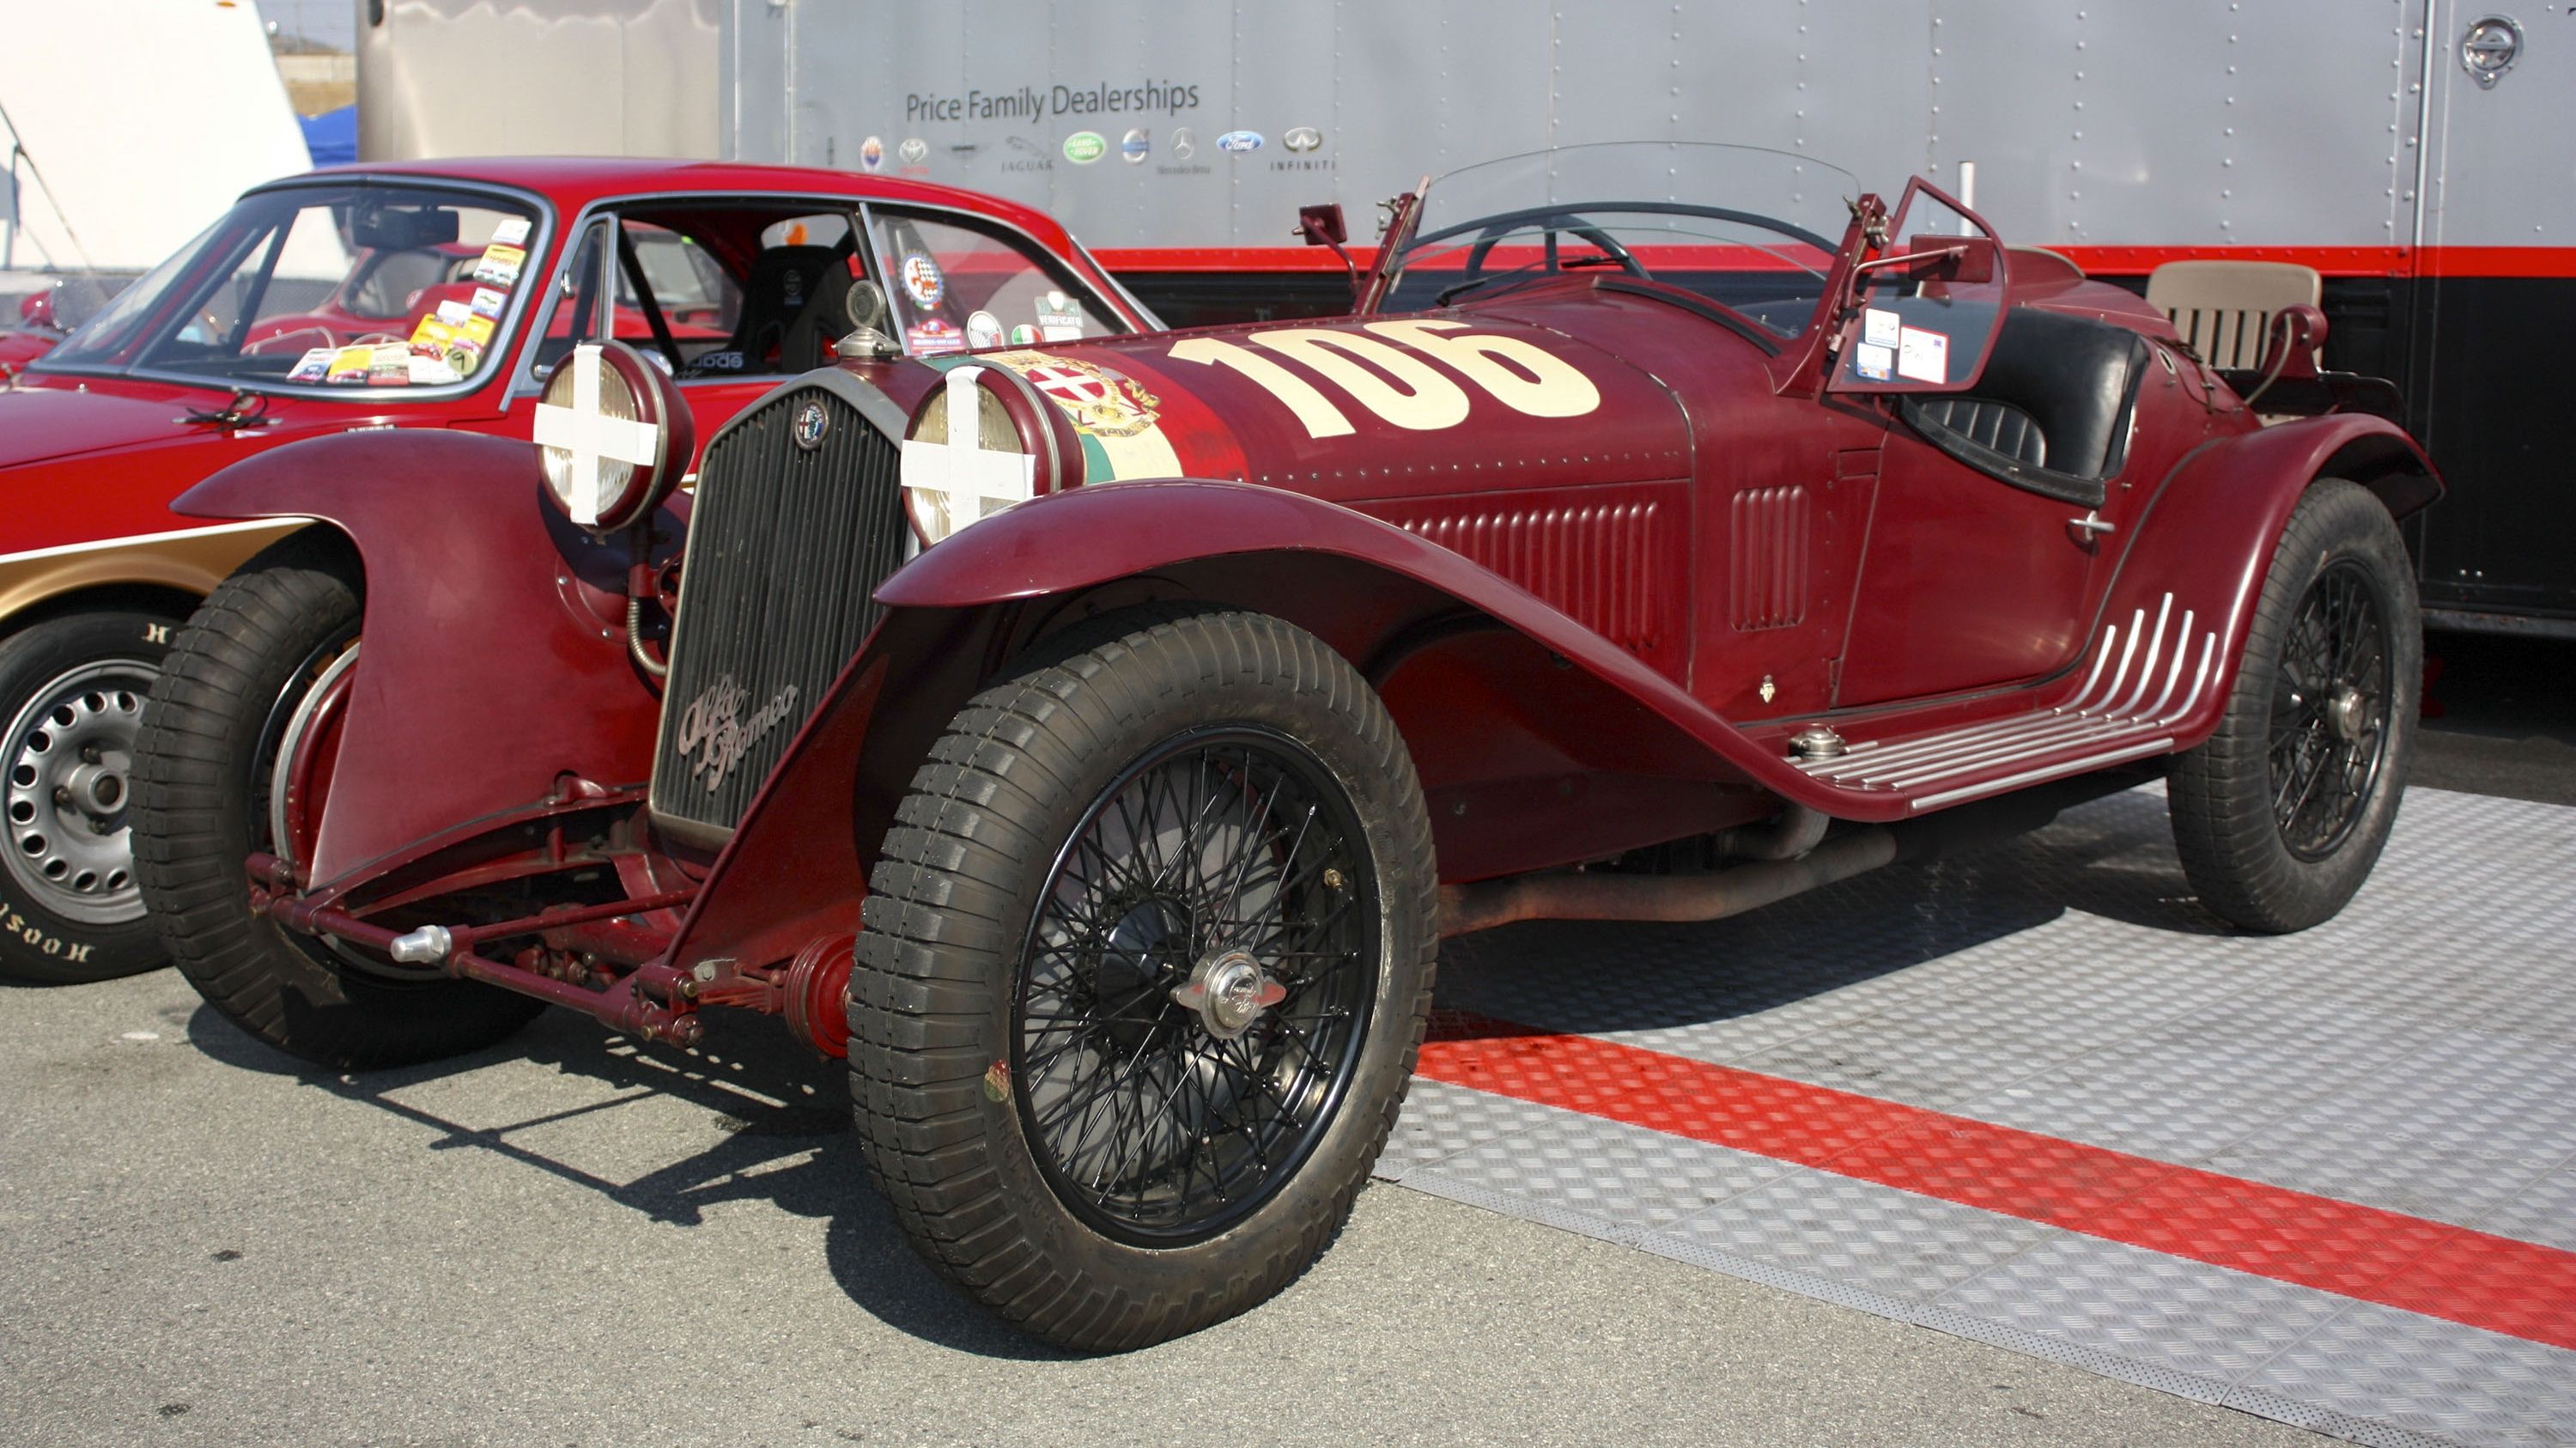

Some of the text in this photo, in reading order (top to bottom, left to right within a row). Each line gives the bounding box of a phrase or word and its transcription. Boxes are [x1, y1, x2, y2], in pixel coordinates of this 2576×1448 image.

[906, 80, 1200, 124] Price Family Dealerships
[1226, 135, 1255, 151] Ford
[1001, 159, 1054, 173] JAGUAR
[1269, 160, 1337, 171] INFINITI
[1038, 314, 1082, 326] VERIFICATO
[1168, 319, 1601, 439] 106
[678, 674, 745, 757] Alfa
[693, 684, 799, 792] Romeo
